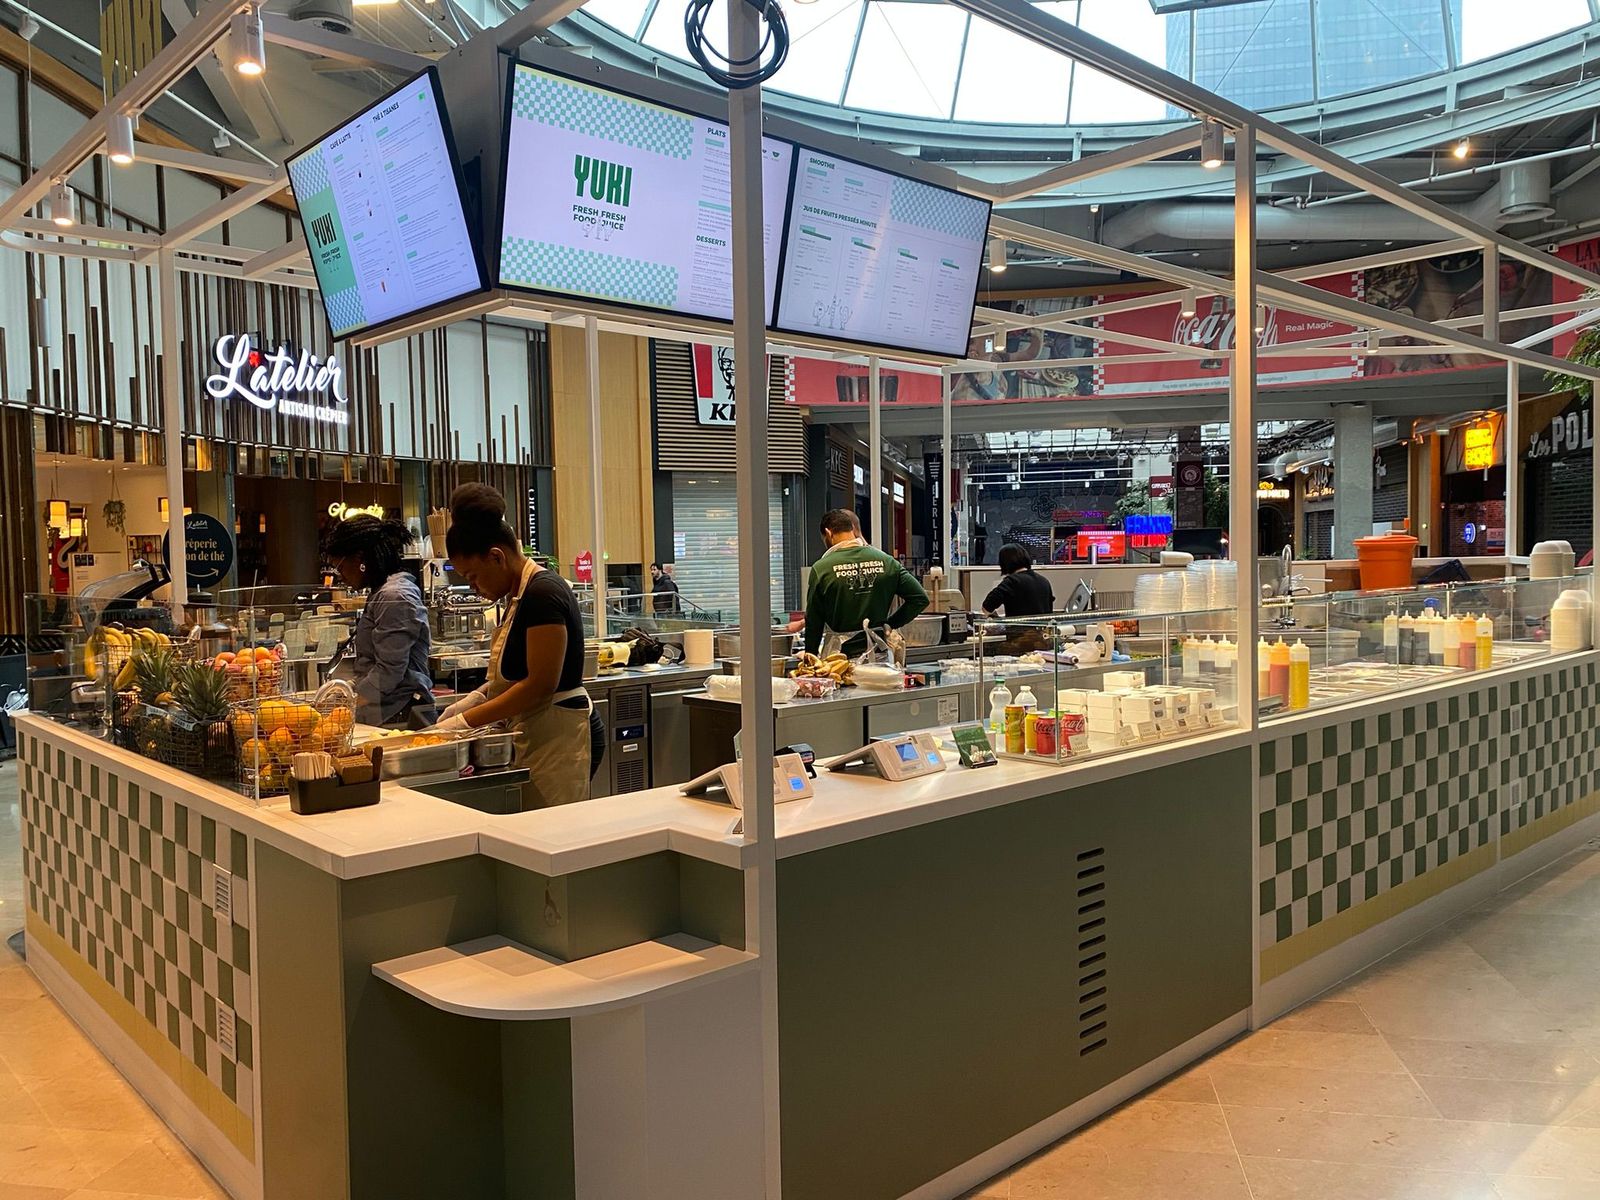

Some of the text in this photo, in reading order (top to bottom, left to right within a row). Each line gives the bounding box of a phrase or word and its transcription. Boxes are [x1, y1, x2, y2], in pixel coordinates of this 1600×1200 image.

[707, 127, 727, 138] PLATS
[809, 157, 835, 169] SMOOTHIE
[574, 154, 632, 207] YUKI
[572, 204, 627, 222] FRESH FRESH
[803, 204, 813, 213] JUS
[820, 210, 838, 219] FRUITS
[311, 212, 337, 248] YUKI
[696, 235, 727, 247] DESSERTS
[1285, 323, 1305, 332] Real
[1306, 320, 1334, 331] Magic
[278, 398, 315, 420] ARTISAN
[1528, 431, 1551, 458] Los
[1551, 409, 1594, 454] POL
[198, 551, 209, 561] de
[210, 550, 225, 561] thé
[833, 560, 884, 571] FRESH FRESH
[836, 567, 885, 578] FOOD JUICE
